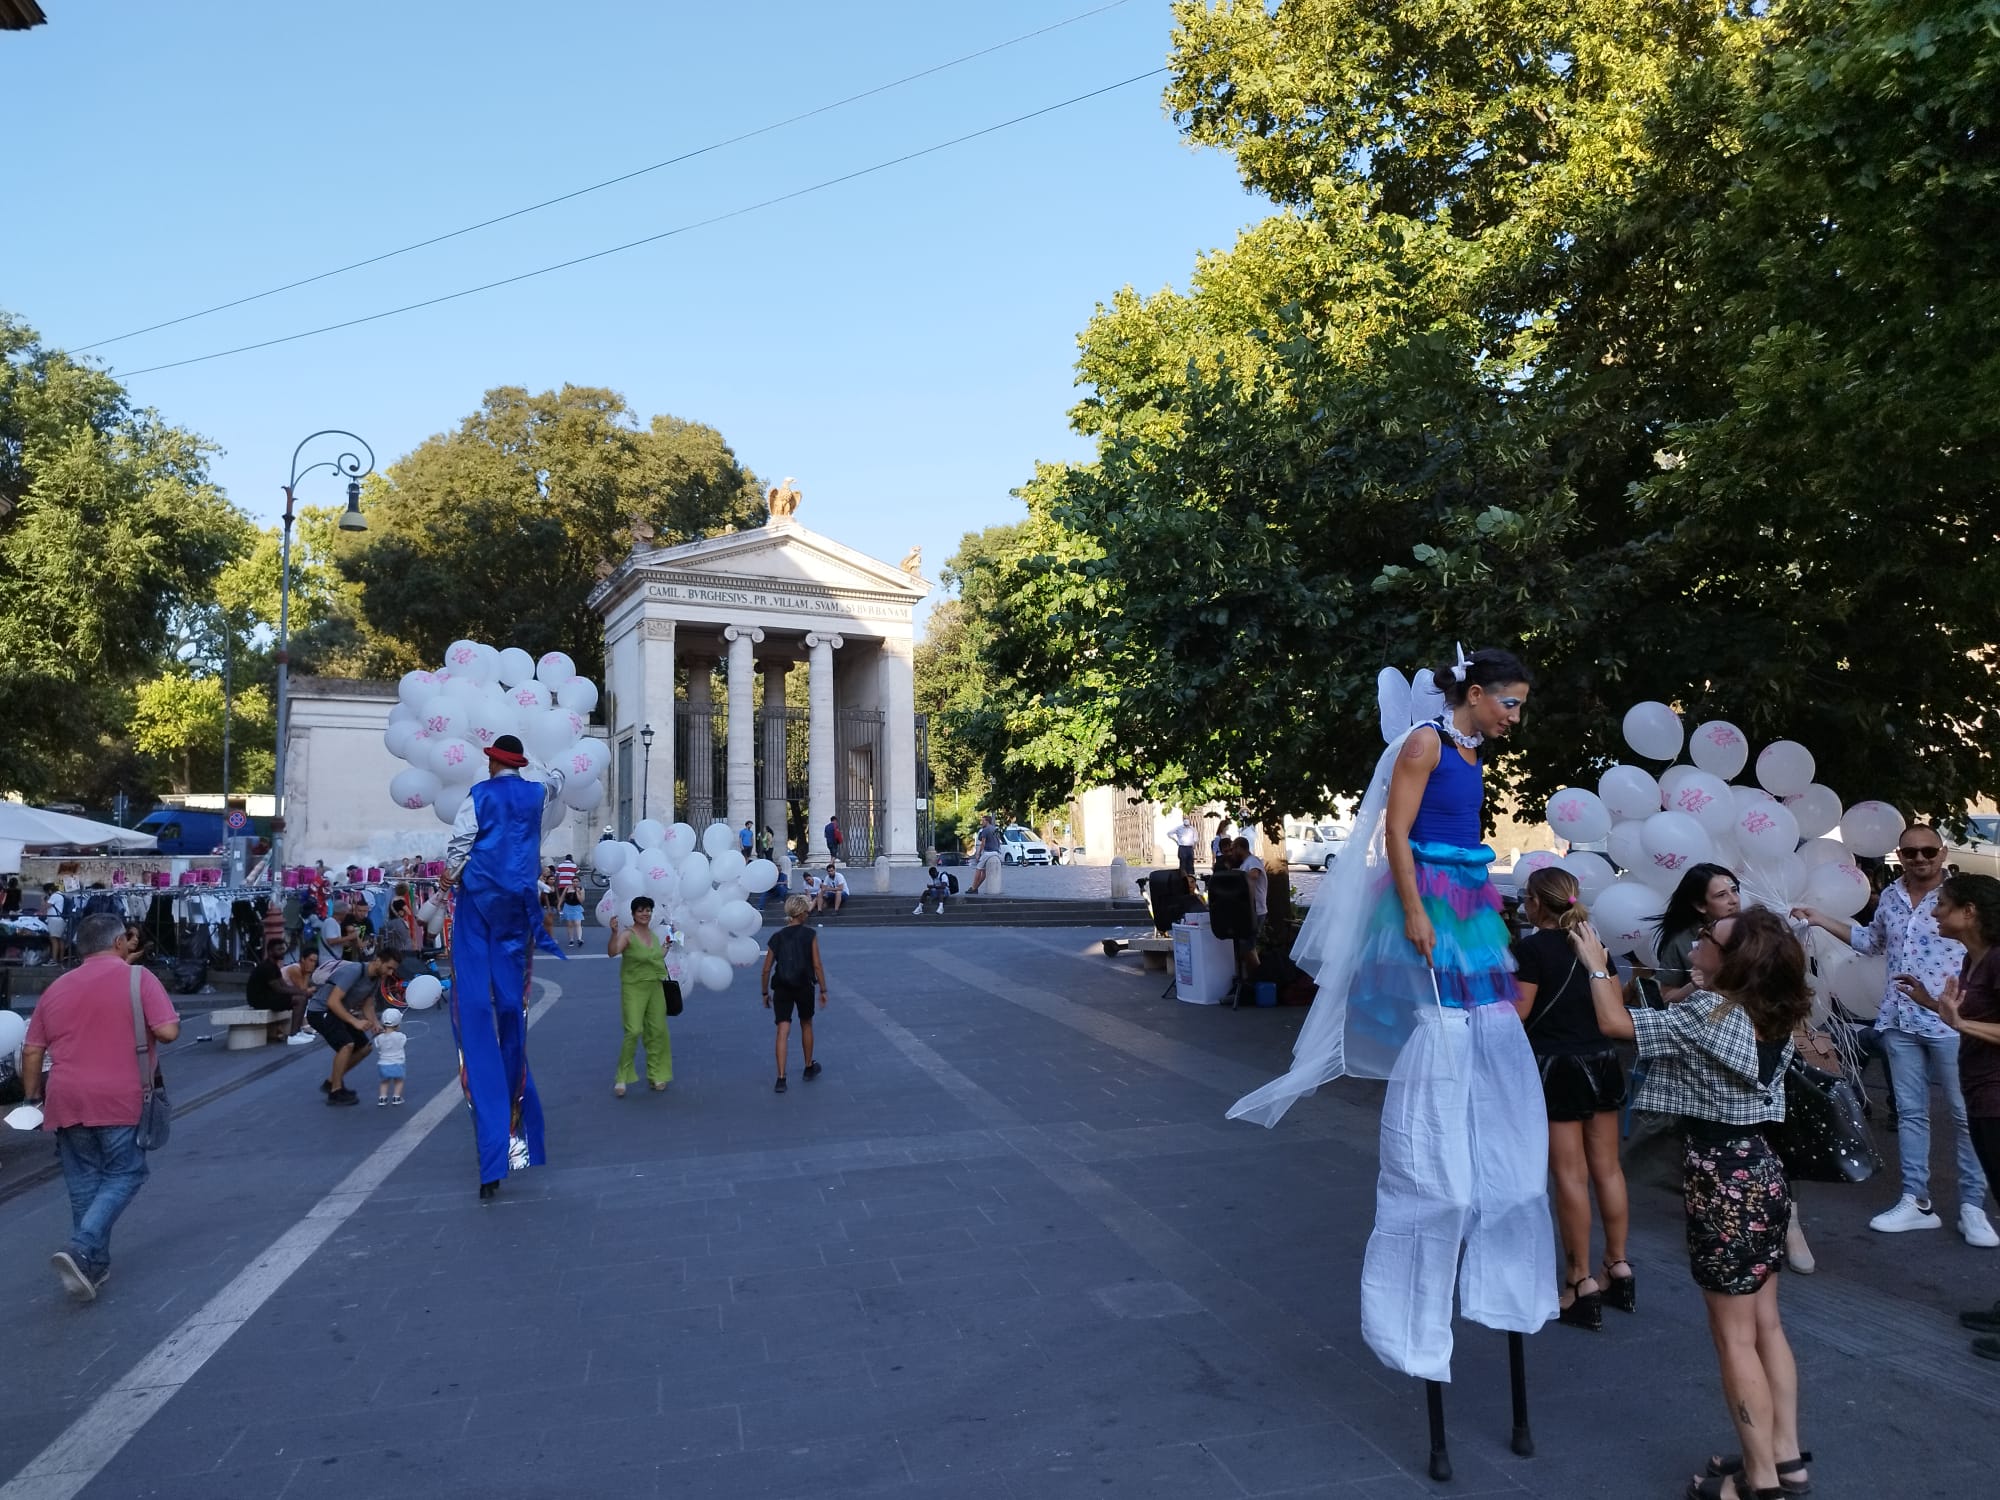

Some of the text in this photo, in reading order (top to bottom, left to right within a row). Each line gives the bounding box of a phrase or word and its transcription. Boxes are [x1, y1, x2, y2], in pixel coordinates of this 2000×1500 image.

[648, 585, 680, 598] CAMIL
[754, 594, 768, 605] PR
[773, 596, 808, 610] VILLAM
[815, 600, 839, 612] SVAM
